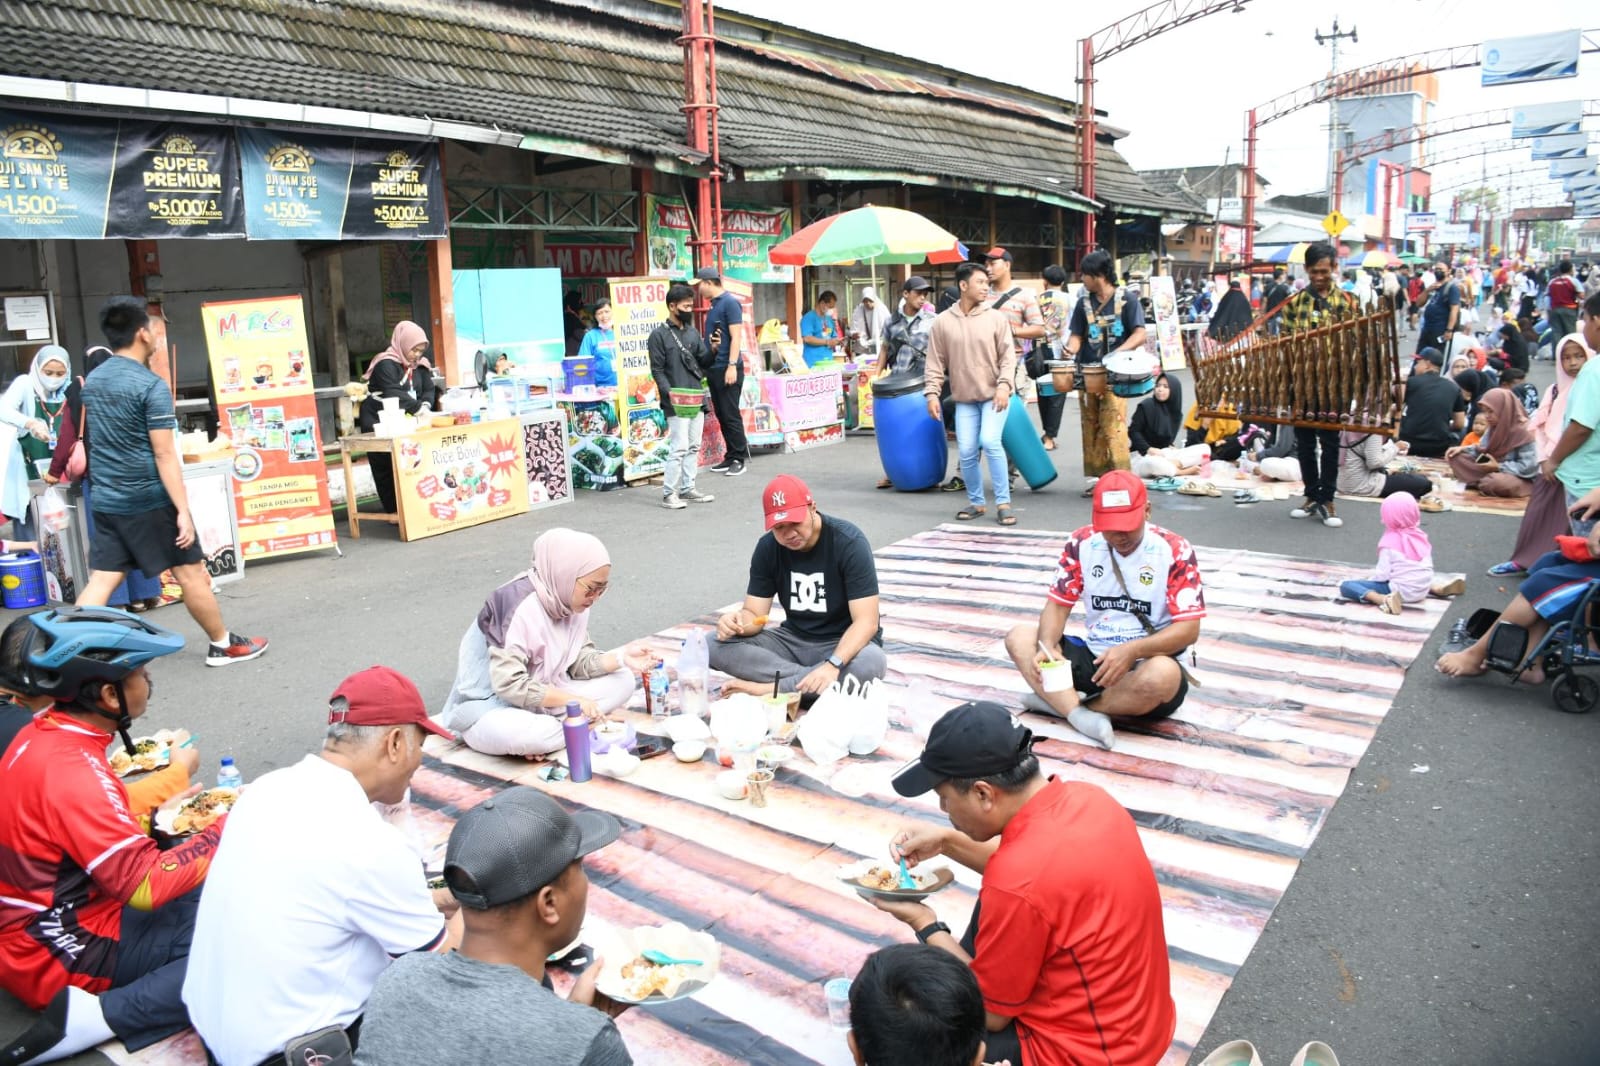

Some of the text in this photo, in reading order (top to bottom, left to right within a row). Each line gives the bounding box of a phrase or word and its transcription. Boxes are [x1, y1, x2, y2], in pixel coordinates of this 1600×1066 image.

[11, 137, 49, 155] 234
[19, 162, 42, 175] SAM
[46, 164, 67, 177] SOE
[153, 156, 208, 171] SUPER
[143, 171, 221, 188] PREMIUM
[301, 175, 317, 187] SOE
[379, 169, 419, 182] SUPER
[0, 176, 69, 191] ELITE
[371, 182, 428, 196] PREMIUM
[266, 185, 318, 198] ELITE
[615, 286, 640, 304] WR
[646, 283, 666, 302] 36
[620, 323, 639, 336] NASI
[619, 340, 637, 352] NASI
[623, 355, 648, 368] ANEKA
[260, 483, 283, 491] TANPA
[771, 490, 786, 507] NY
[250, 502, 274, 510] TANPA
